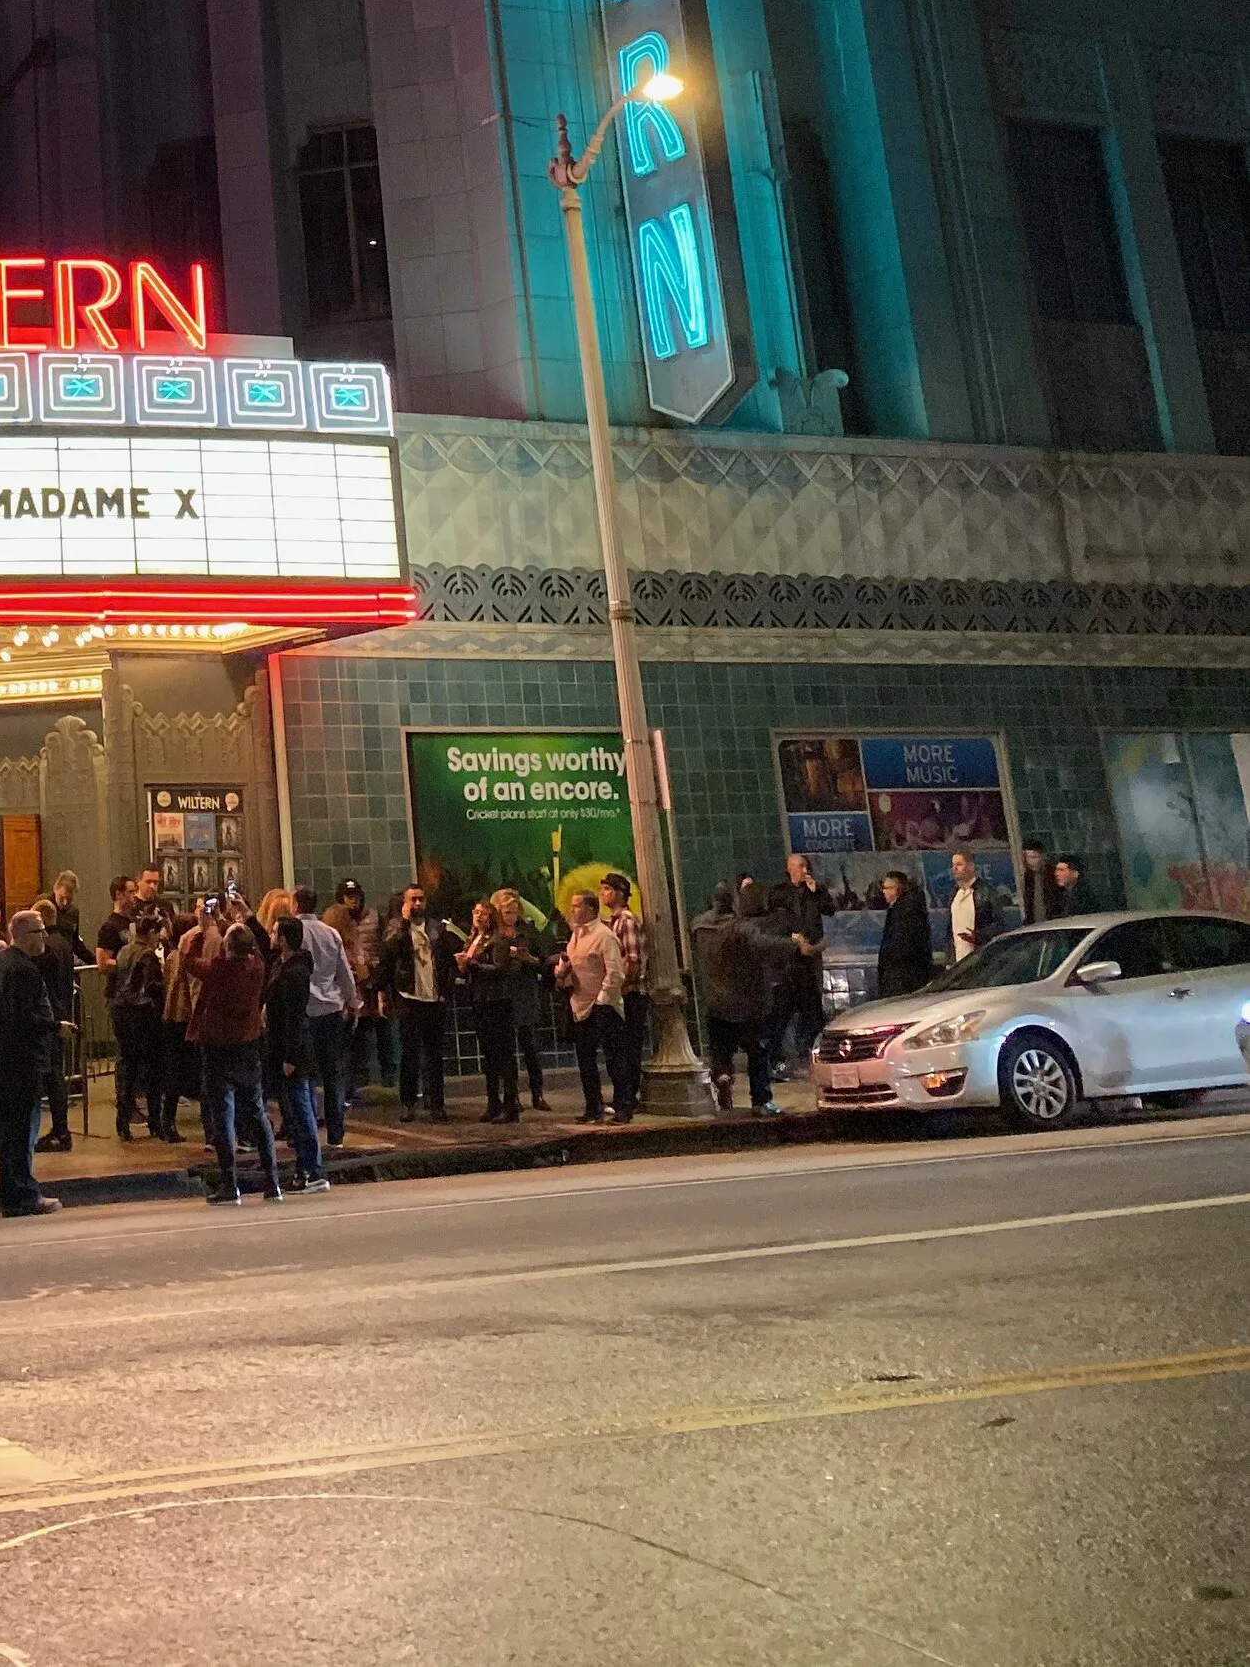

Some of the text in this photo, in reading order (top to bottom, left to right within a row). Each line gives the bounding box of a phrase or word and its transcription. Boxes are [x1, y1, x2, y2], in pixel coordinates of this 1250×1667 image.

[175, 489, 200, 521] X
[446, 746, 626, 778] Savings worthy
[903, 745, 955, 764] MORE
[906, 766, 958, 784] MUSIC
[463, 776, 620, 802] of an encore.
[177, 795, 221, 811] WILTERN
[466, 808, 499, 821] Cricket
[500, 808, 526, 821] plans
[527, 808, 547, 820] start
[548, 808, 559, 819] at
[561, 808, 579, 820] only
[803, 818, 854, 838] MORE
